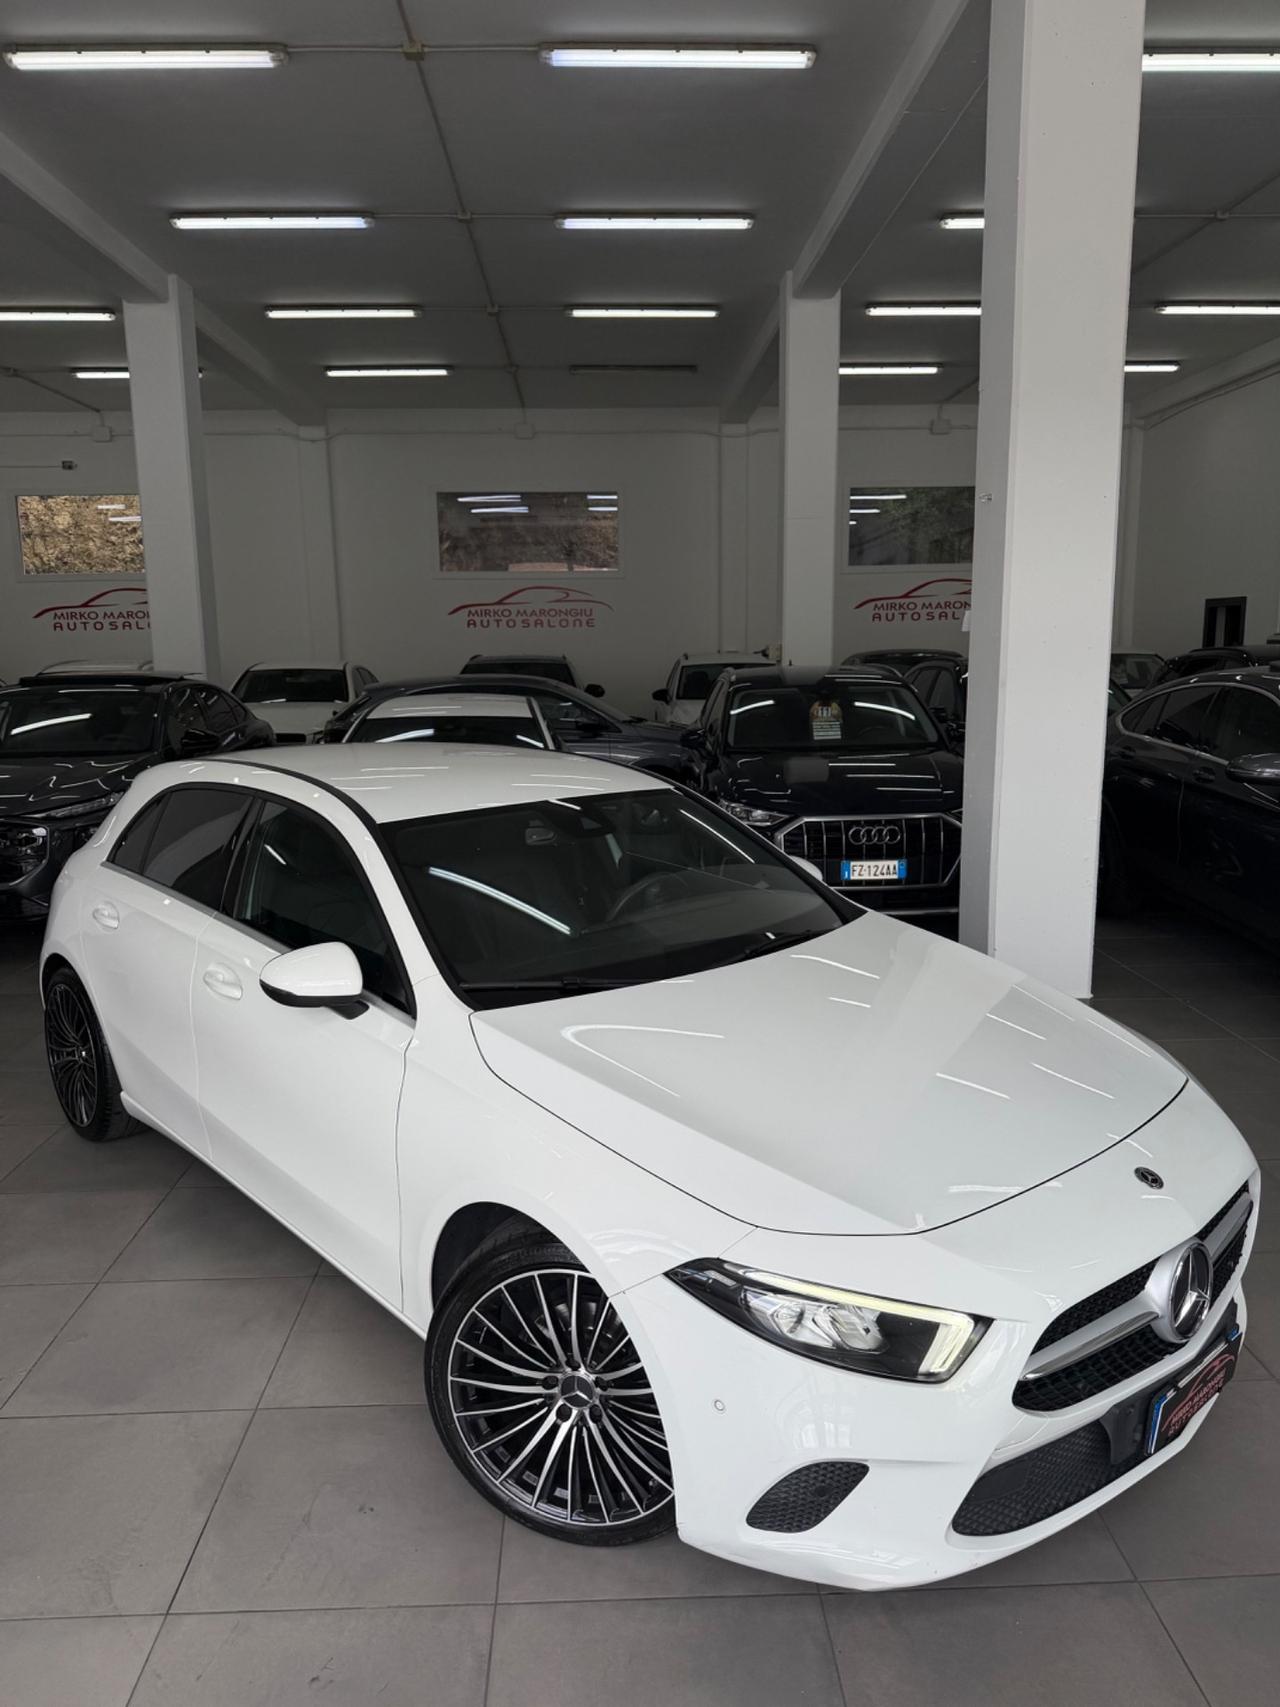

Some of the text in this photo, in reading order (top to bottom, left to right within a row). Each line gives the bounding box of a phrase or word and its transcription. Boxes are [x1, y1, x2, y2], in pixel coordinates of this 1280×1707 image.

[873, 601, 918, 611] MIRKO
[53, 610, 99, 620] MIRKO
[467, 608, 593, 618] MIRKO MARONGIU
[53, 621, 151, 632] AUTOSAL
[466, 618, 596, 629] AUTOSALONE
